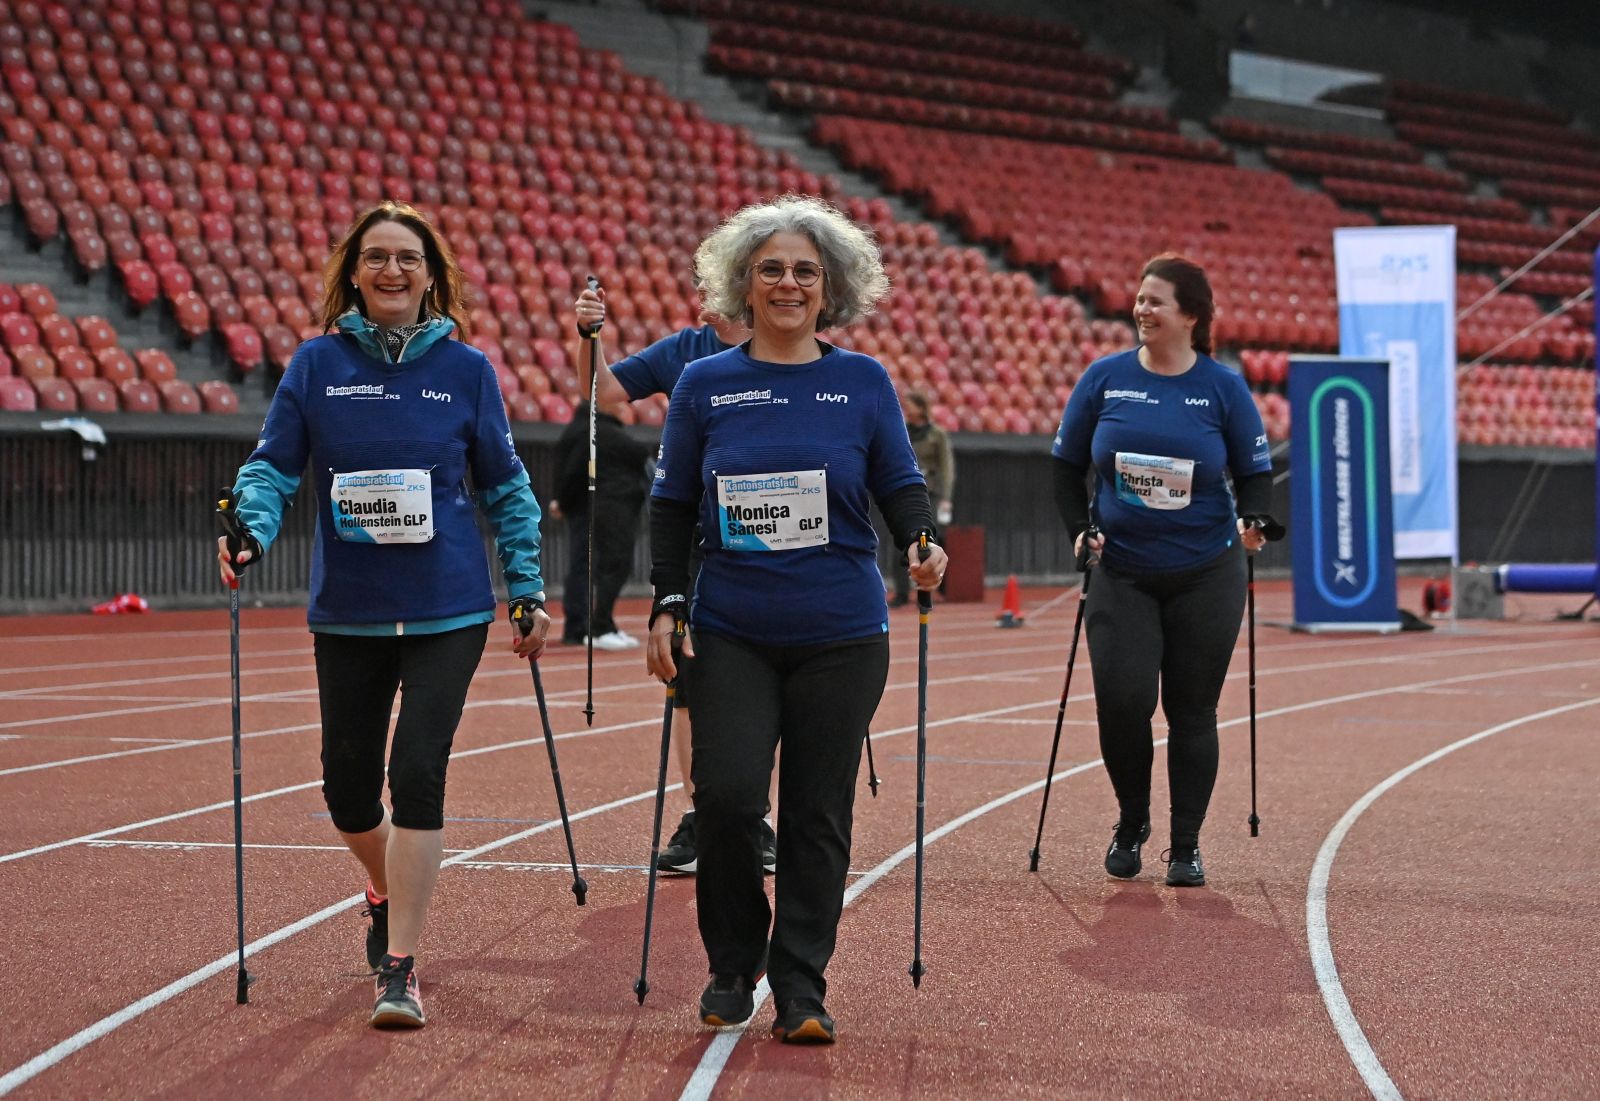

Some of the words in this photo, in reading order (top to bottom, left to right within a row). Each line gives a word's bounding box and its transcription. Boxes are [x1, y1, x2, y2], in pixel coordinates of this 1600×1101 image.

[725, 476, 799, 493] Kantonsratslauf
[1120, 472, 1163, 487] Christa
[406, 484, 426, 492] ZKS
[801, 487, 821, 495] ZKS
[1169, 488, 1187, 498] GLP
[338, 498, 397, 515] Claudia
[726, 503, 791, 521] Monica
[340, 515, 401, 528] Hollenstein
[403, 514, 428, 526] GLP
[728, 520, 777, 537] Sanesi
[799, 517, 823, 531] GLP
